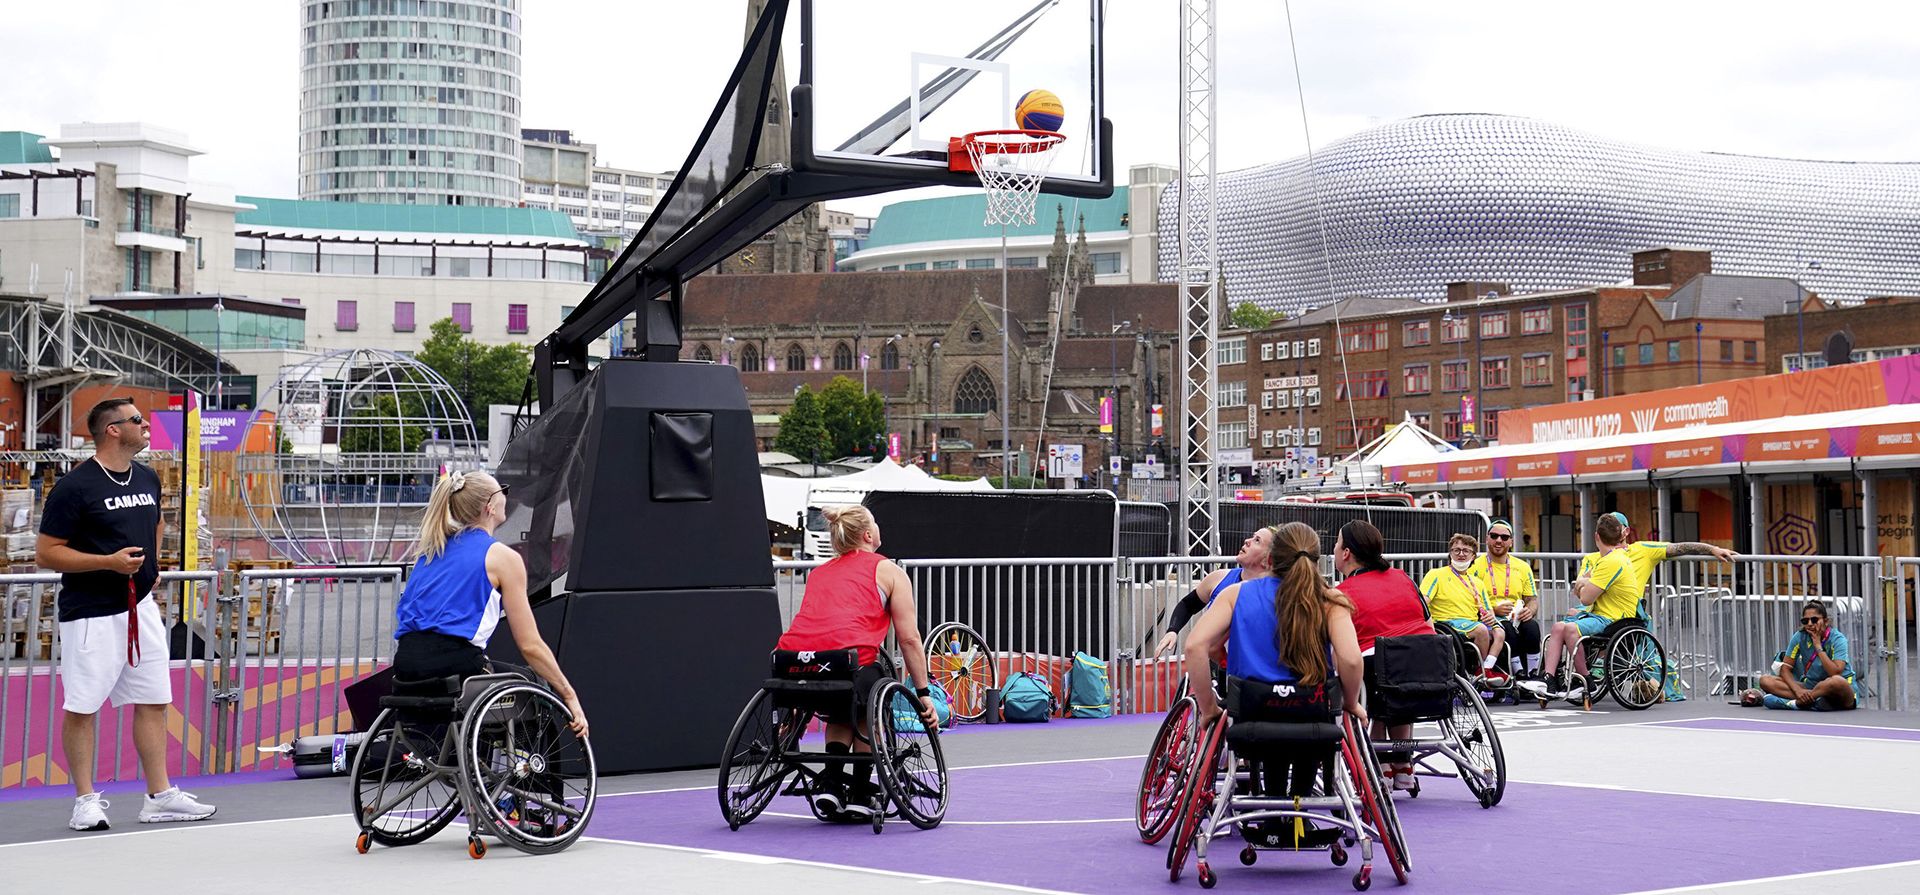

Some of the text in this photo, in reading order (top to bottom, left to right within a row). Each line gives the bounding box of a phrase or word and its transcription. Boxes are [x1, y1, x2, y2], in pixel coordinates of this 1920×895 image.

[1265, 379, 1283, 388] FANCY
[1664, 396, 1729, 423] commonwealth
[199, 417, 236, 427] MINGHAM
[1532, 413, 1622, 443] BIRMINGHAM 2022
[103, 493, 156, 510] CANADA
